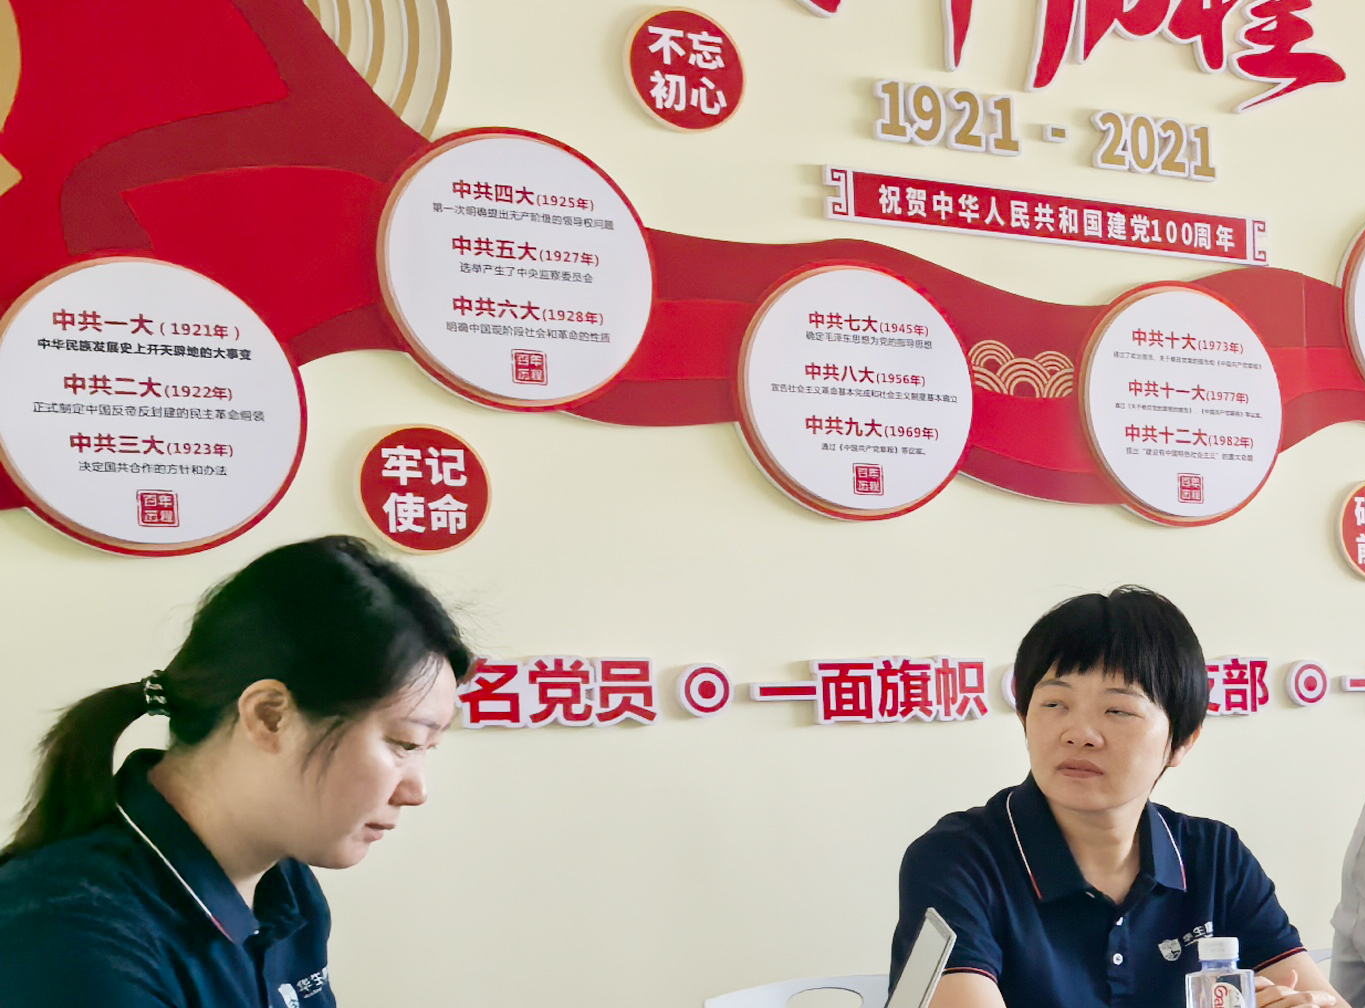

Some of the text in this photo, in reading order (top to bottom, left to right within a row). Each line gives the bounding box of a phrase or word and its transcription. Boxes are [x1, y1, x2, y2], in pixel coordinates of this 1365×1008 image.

[648, 26, 725, 71] 不忘
[649, 72, 728, 116] 初心
[878, 80, 1021, 154] 1921
[1097, 111, 1218, 181] 2021
[878, 184, 1236, 253] 祝贺中华人民共和国建党100周年
[37, 338, 252, 361] 中华民族发展史上开天辟地的大事变
[381, 446, 468, 487] 牢记
[382, 492, 469, 535] 使命
[758, 658, 985, 721] 一面旗帜
